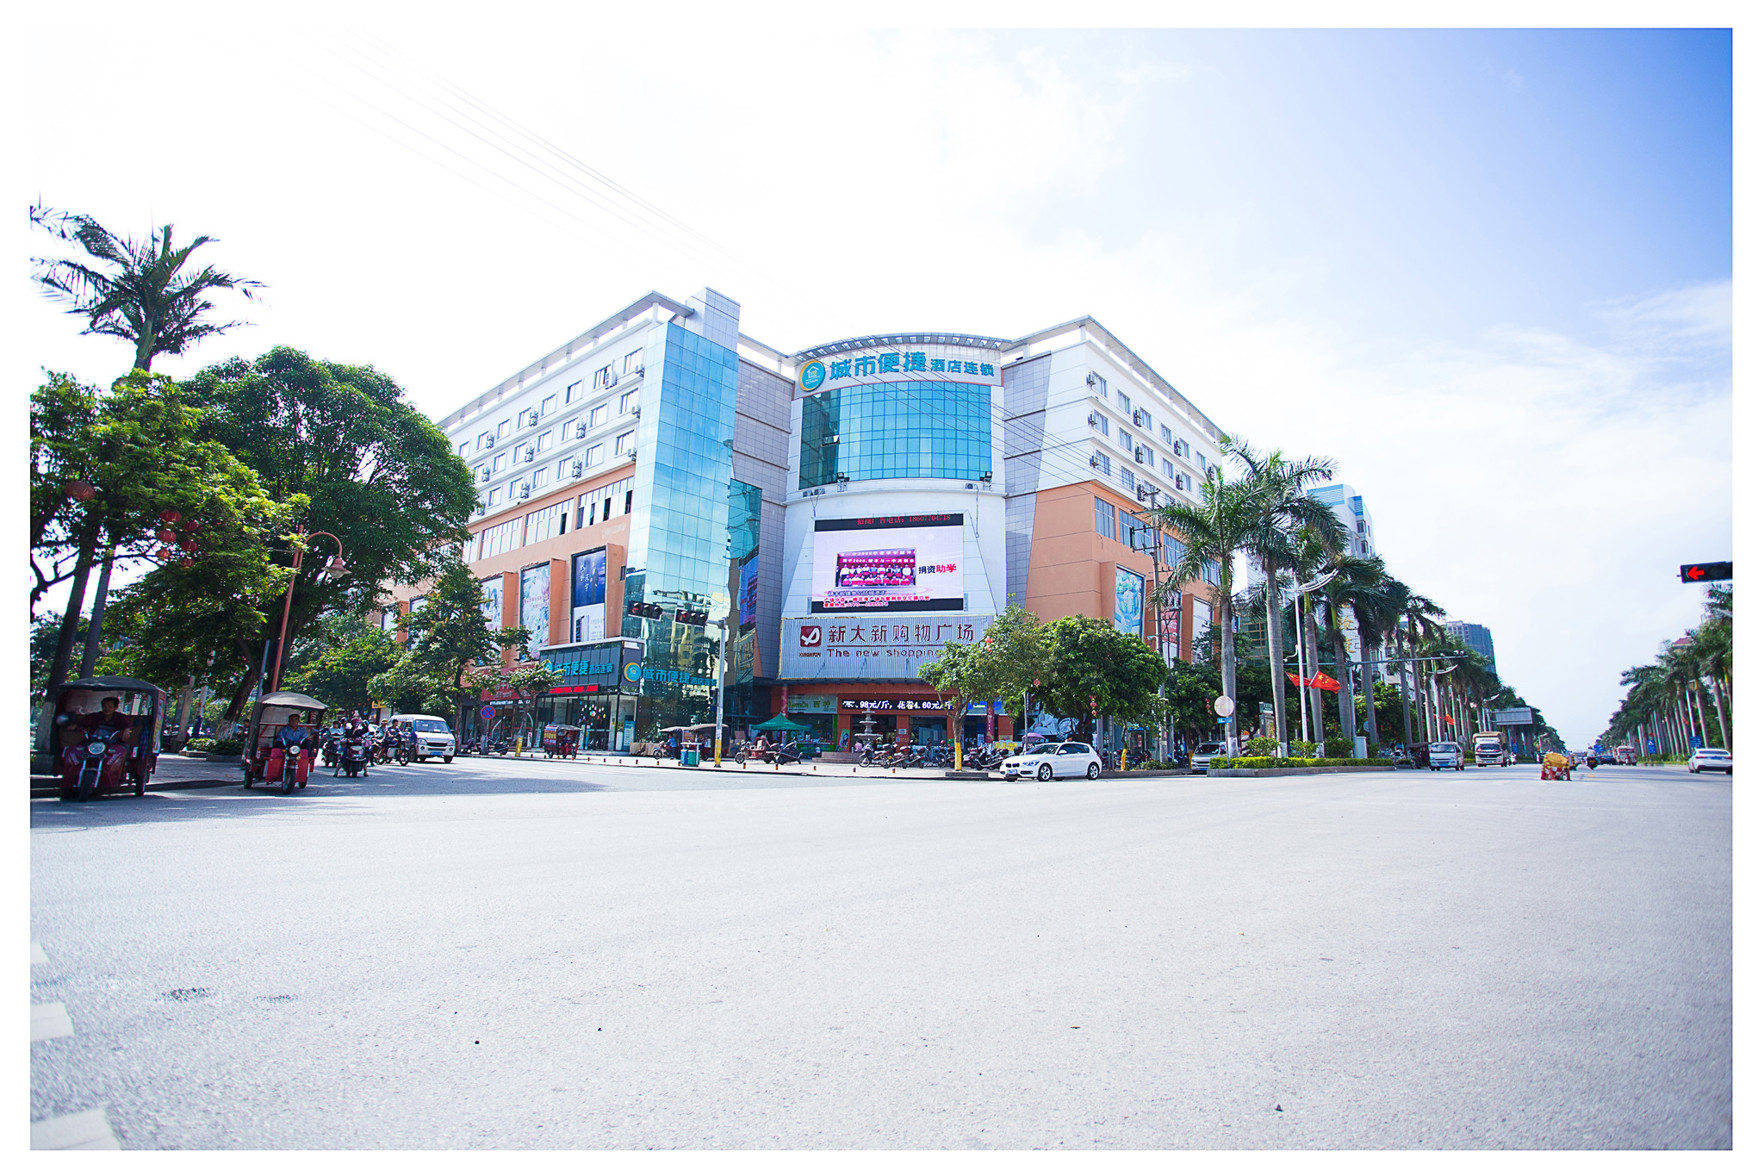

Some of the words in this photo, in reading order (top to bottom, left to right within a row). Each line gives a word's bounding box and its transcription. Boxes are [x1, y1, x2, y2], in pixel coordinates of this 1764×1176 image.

[829, 352, 927, 380] 城市便捷
[930, 358, 995, 377] 酒店连锁
[918, 563, 957, 574] 捐资助学
[829, 624, 974, 643] 新大新购物广场
[826, 648, 849, 657] The
[886, 648, 942, 659] shopping
[642, 667, 690, 685] 城市便捷
